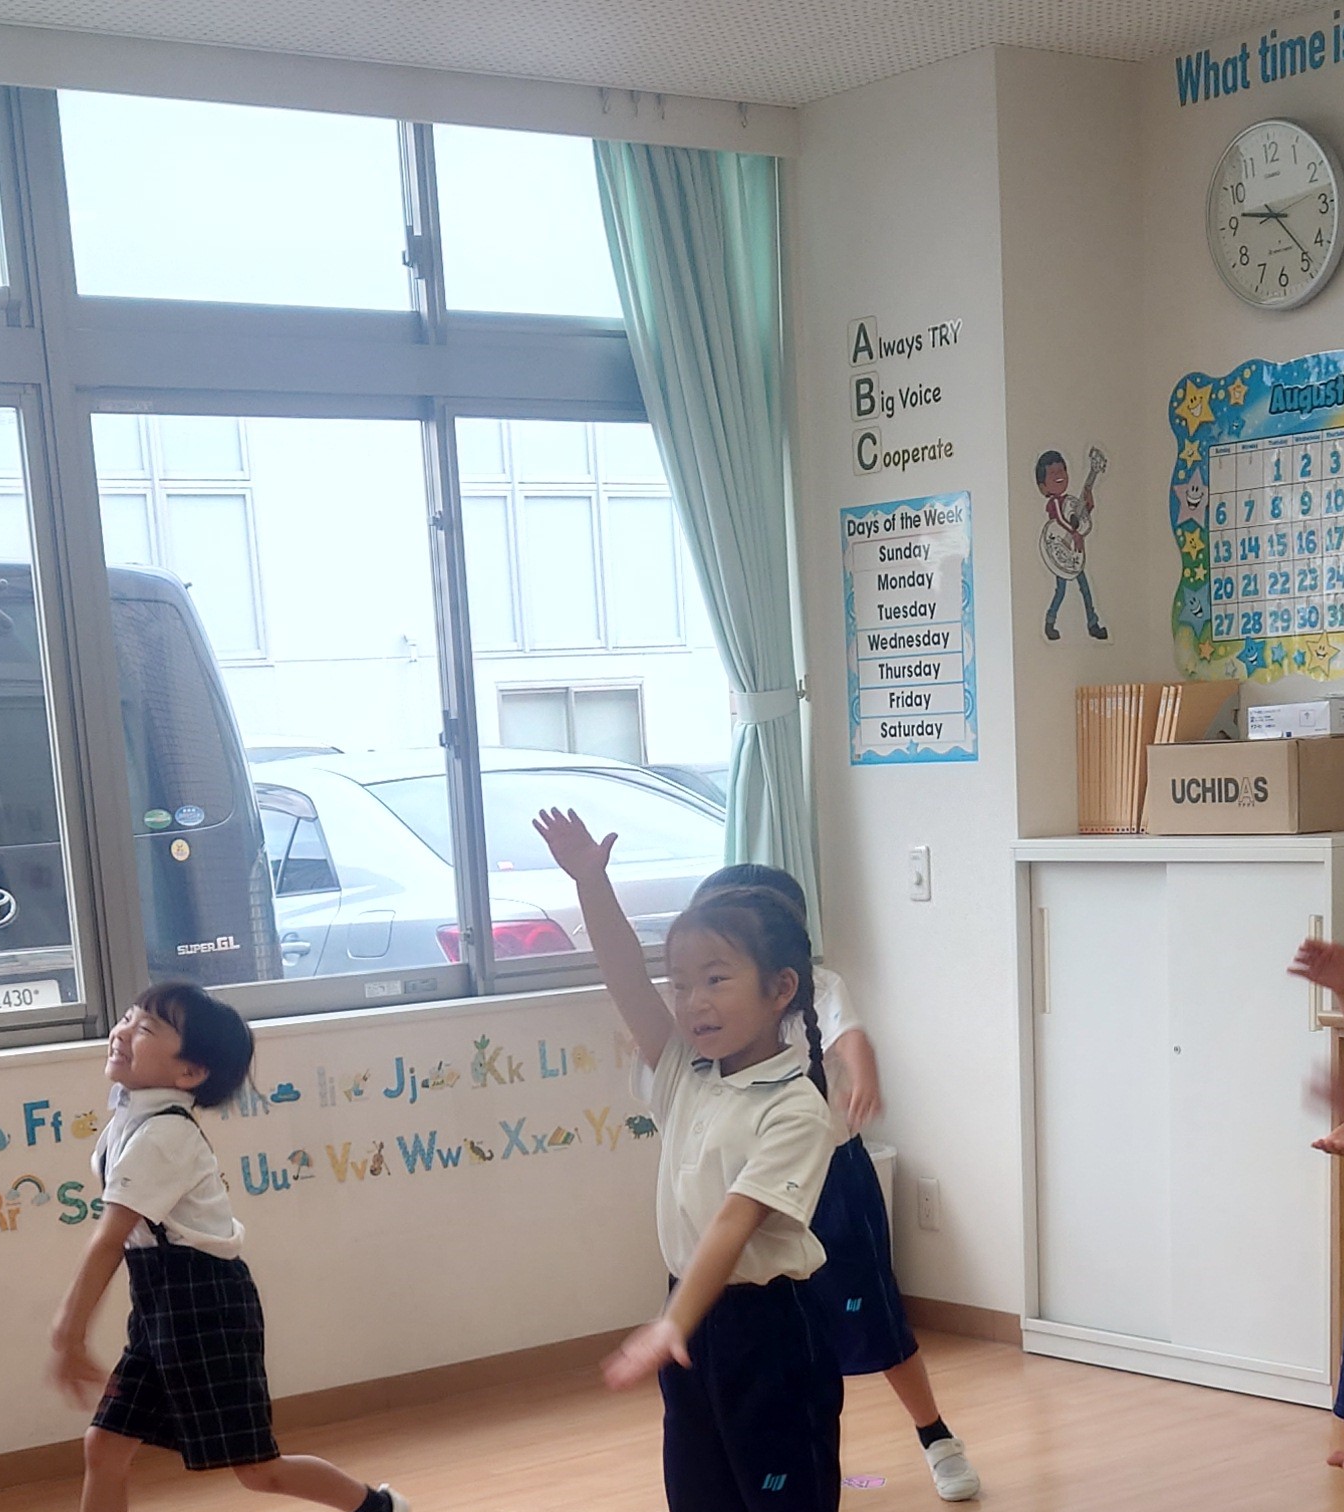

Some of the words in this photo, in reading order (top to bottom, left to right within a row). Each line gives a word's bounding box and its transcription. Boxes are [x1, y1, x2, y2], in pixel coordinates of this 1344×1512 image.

[1175, 42, 1250, 107] What
[1258, 29, 1326, 83] time
[1262, 141, 1280, 164] 12
[1291, 144, 1298, 165] 1
[1242, 157, 1256, 179] 11
[1307, 162, 1318, 183] 2
[1229, 182, 1246, 205] 10
[1317, 193, 1330, 214] 3
[1228, 216, 1239, 237] 9
[1313, 227, 1324, 247] 4
[1239, 245, 1250, 266] 8
[1300, 251, 1311, 273] 5
[1257, 263, 1267, 284] 7
[1278, 266, 1289, 288] 6
[852, 322, 923, 363] Always
[928, 320, 962, 348] TRY
[855, 377, 895, 418] Big
[898, 383, 942, 409] Voice
[857, 431, 953, 471] Cooperate
[1273, 457, 1282, 481] 1
[1299, 453, 1311, 478] 2
[1330, 451, 1341, 474] 3
[1215, 502, 1227, 525] 6
[1244, 500, 1255, 522] 7
[1270, 496, 1282, 518] 8
[1300, 491, 1312, 515] 9
[847, 518, 879, 538] Days
[883, 513, 896, 533] of
[900, 511, 922, 530] the
[923, 505, 964, 527] Week
[879, 542, 931, 562] Sunday
[1214, 540, 1232, 563] 13
[1240, 536, 1260, 561] 14
[1267, 533, 1287, 557] 15
[1296, 529, 1317, 555] 16
[877, 571, 934, 591] Monday
[1213, 576, 1234, 600] 20
[1241, 574, 1259, 597] 21
[1268, 571, 1291, 595] 22
[1297, 567, 1319, 592] 23
[877, 601, 937, 620] Tuesday
[1214, 613, 1234, 636] 27
[1241, 611, 1262, 635] 28
[1269, 608, 1292, 633] 29
[1296, 605, 1319, 629] 30
[867, 629, 950, 651] Wednesday
[878, 660, 941, 680] Thursday
[889, 690, 931, 710] Friday
[880, 720, 943, 739] Saturday
[177, 943, 216, 955] SUPER
[216, 935, 240, 951] GL
[23, 1100, 63, 1146] Ff
[383, 1057, 419, 1104] Jj
[482, 1046, 526, 1087] Kk
[240, 1152, 291, 1196] Uu
[325, 1141, 369, 1183] Vv
[396, 1130, 462, 1174] Ww
[499, 1116, 549, 1160] Xx
[584, 1106, 623, 1152] Yy
